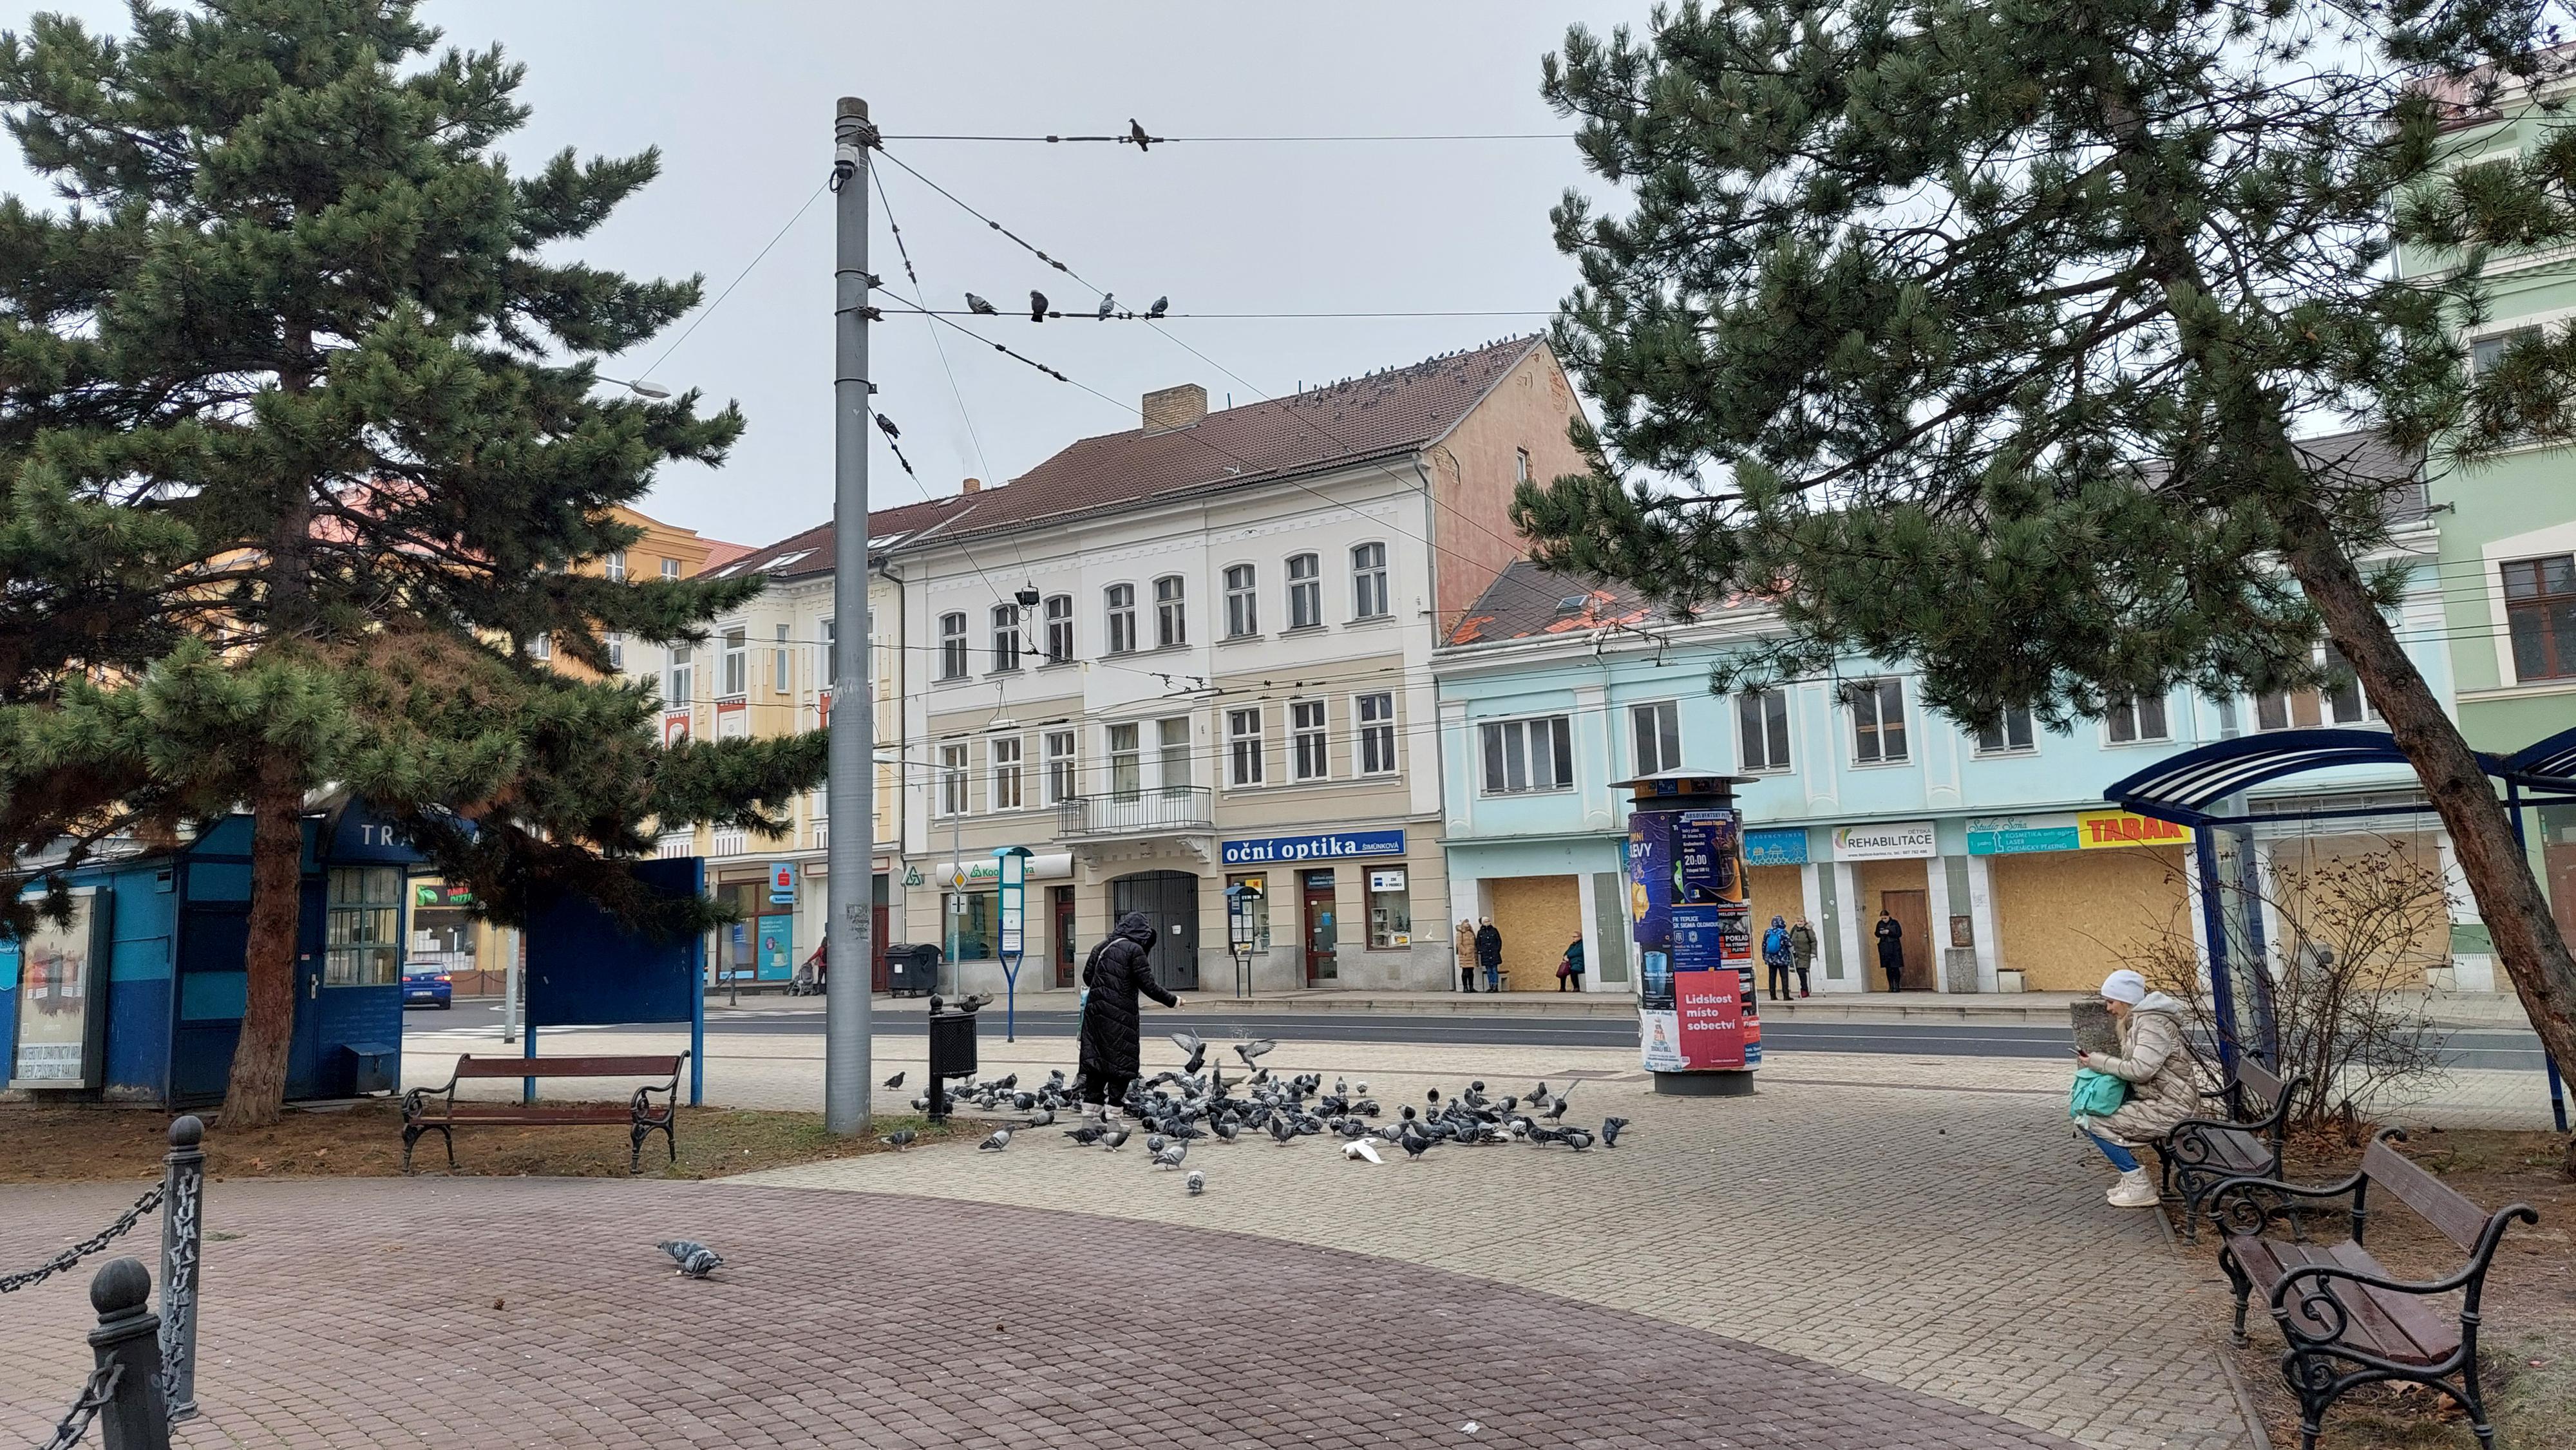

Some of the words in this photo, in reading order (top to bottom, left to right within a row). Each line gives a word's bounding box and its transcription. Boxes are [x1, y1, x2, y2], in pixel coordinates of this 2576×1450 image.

[1969, 818, 2000, 832] Studio
[1848, 834, 1932, 849] REHABILITACE
[1226, 840, 1274, 862] oční
[1282, 837, 1356, 859] optika
[1684, 854, 1707, 865] 20:00
[1685, 993, 1732, 1004] Lidskost
[1687, 1007, 1719, 1017] místo
[1687, 1019, 1736, 1030] sobectví
